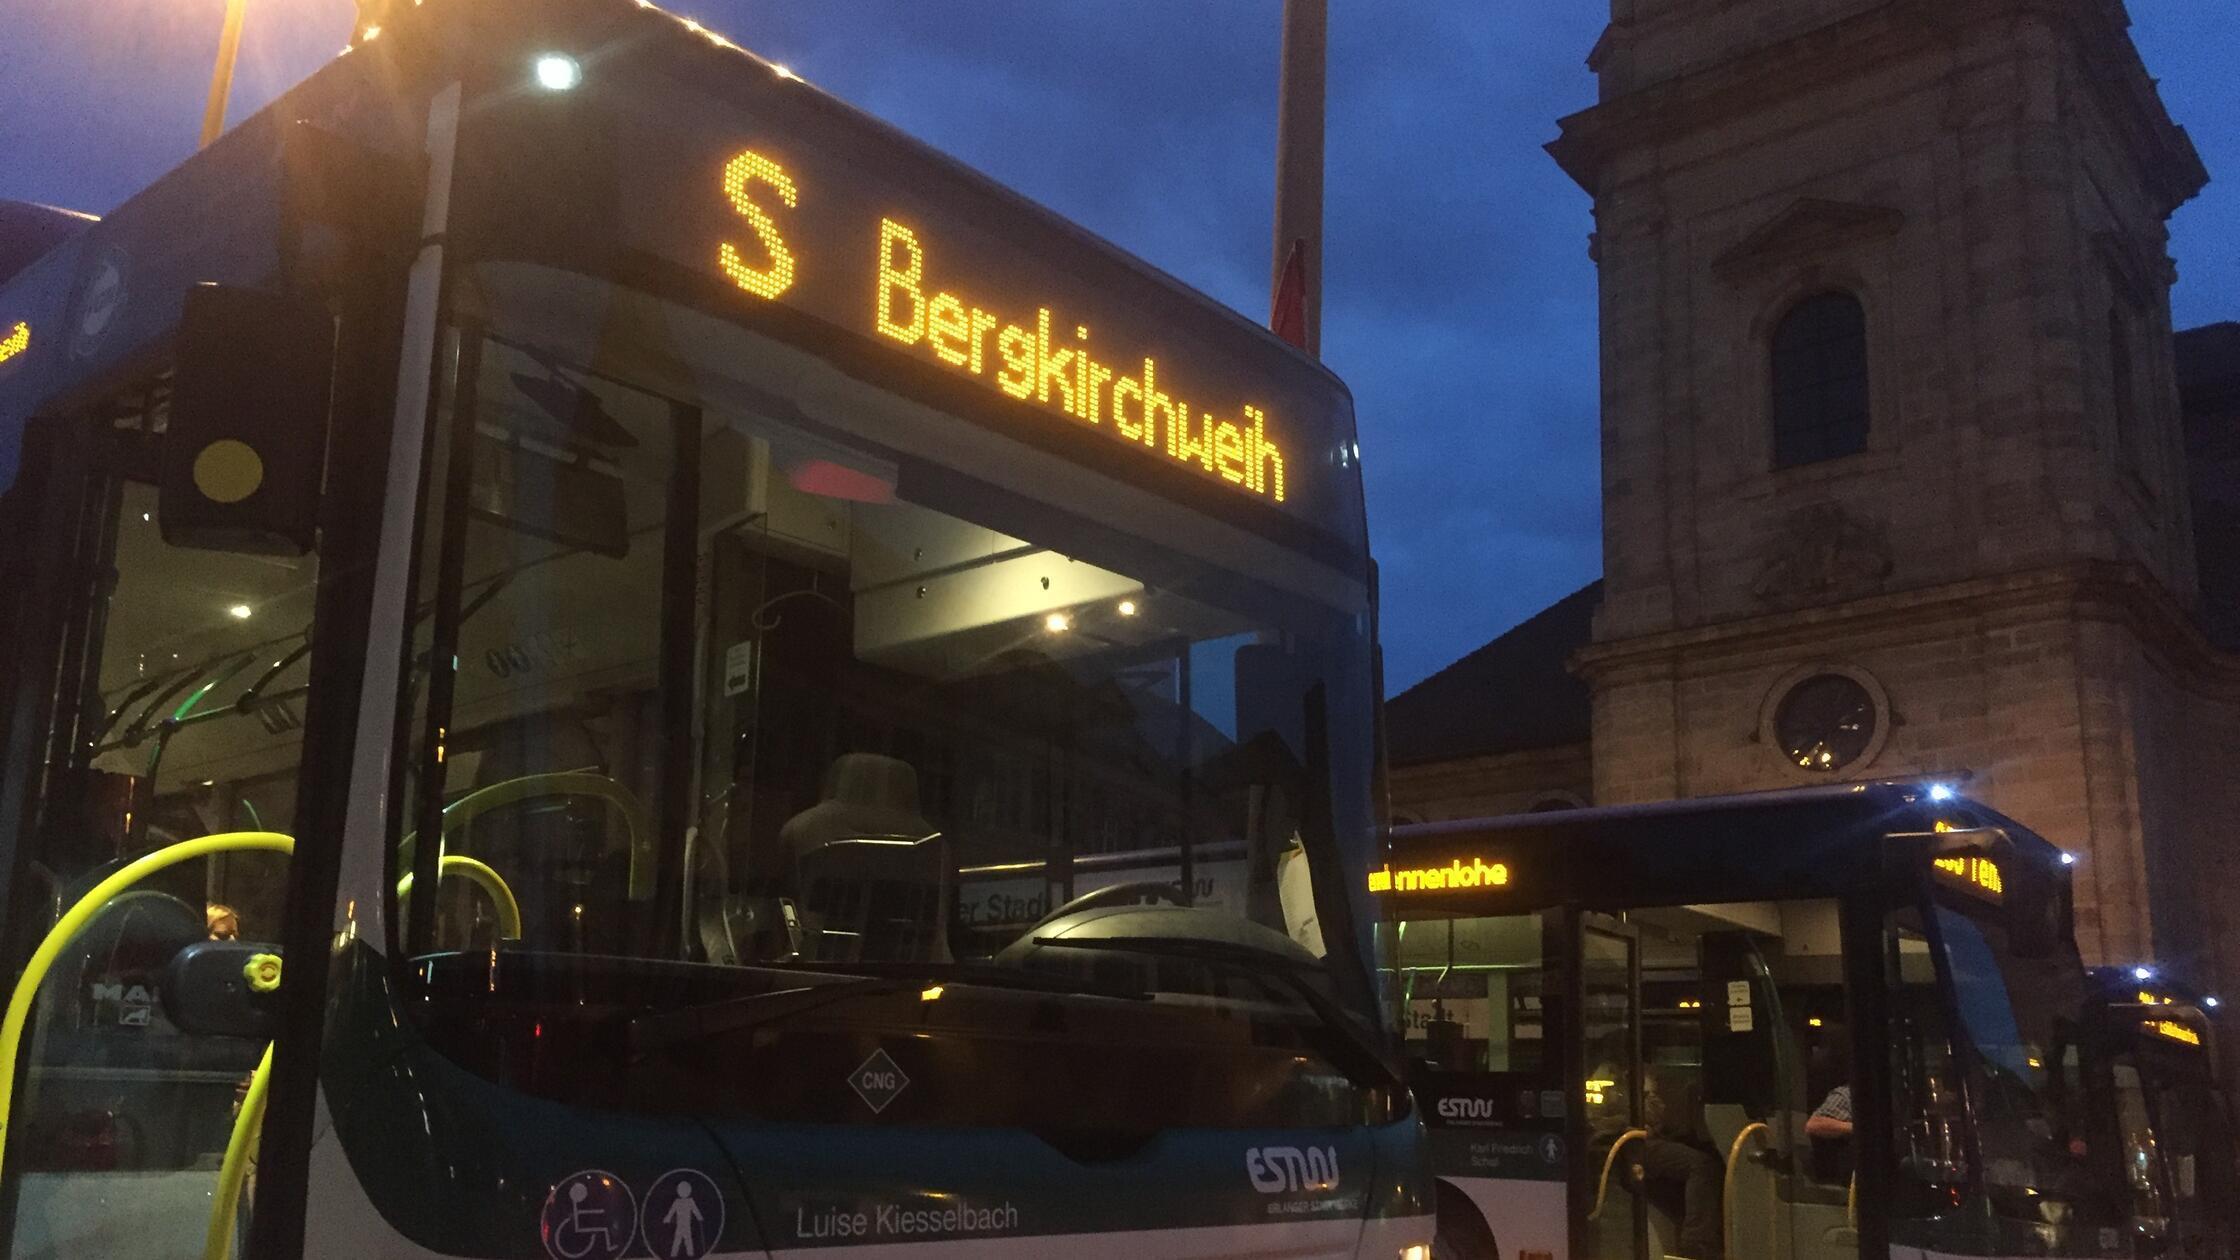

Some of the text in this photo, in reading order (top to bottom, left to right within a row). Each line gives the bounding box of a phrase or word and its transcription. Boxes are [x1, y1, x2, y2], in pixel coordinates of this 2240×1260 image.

[720, 150, 1285, 503] S Bergkirchweih
[1395, 857, 1508, 892] nnenlohe
[862, 1071, 896, 1090] CNG
[1245, 1145, 1340, 1194] ESTW
[796, 1201, 1019, 1239] Luise Kiesselbach
